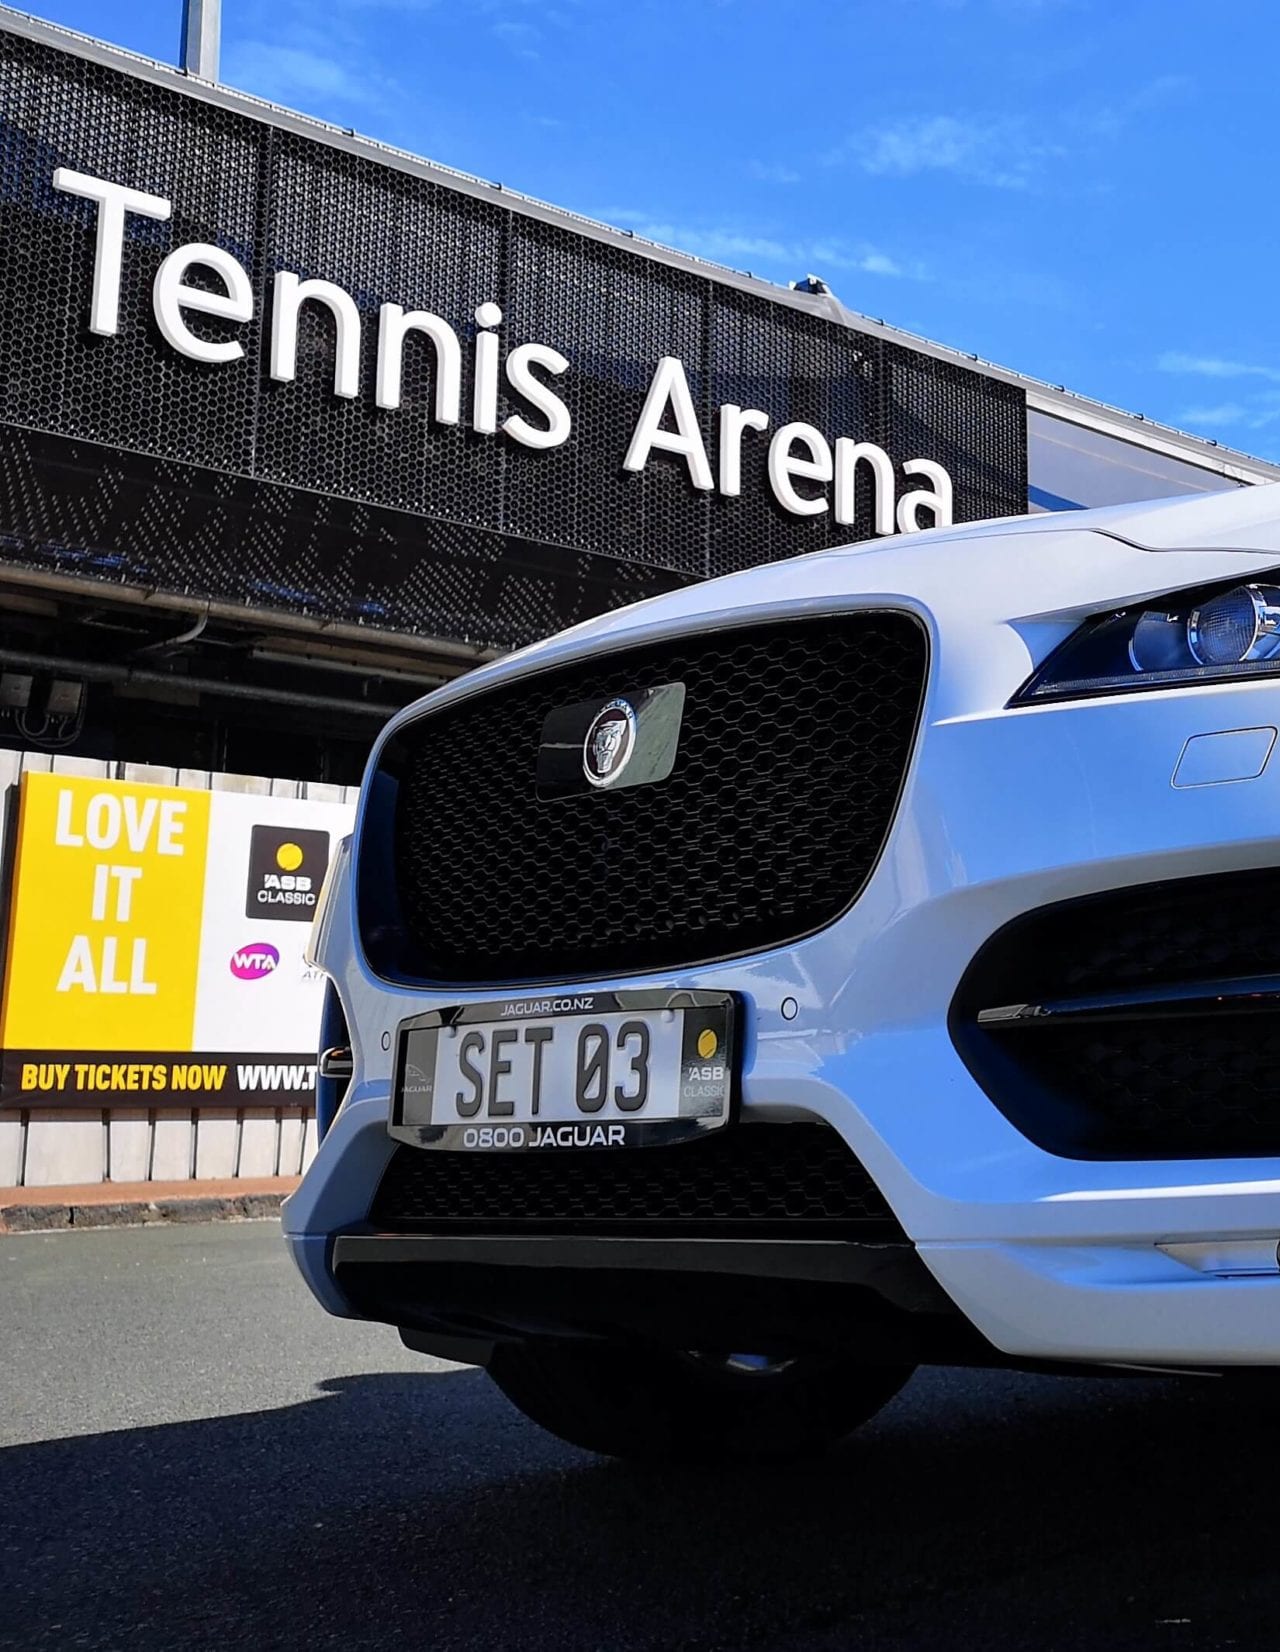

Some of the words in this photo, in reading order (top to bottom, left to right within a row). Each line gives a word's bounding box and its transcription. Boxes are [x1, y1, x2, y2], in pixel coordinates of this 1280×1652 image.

[53, 167, 571, 449] Tennis
[623, 356, 955, 536] Arena
[55, 789, 188, 857] LOVE
[91, 864, 142, 923] IT
[257, 890, 316, 906] CLASSIC
[55, 935, 158, 995] ALL
[234, 953, 277, 970] WTA
[500, 997, 594, 1017] JAGUAR.CO.NZ
[21, 1063, 69, 1091] BUY
[74, 1064, 166, 1092] TICKETS
[171, 1064, 228, 1091] NOW
[236, 1064, 318, 1091] WWW.T
[455, 1027, 554, 1118] SET
[575, 1020, 650, 1113] 03
[463, 1127, 525, 1148] 0800
[528, 1125, 626, 1148] JAGUAR
